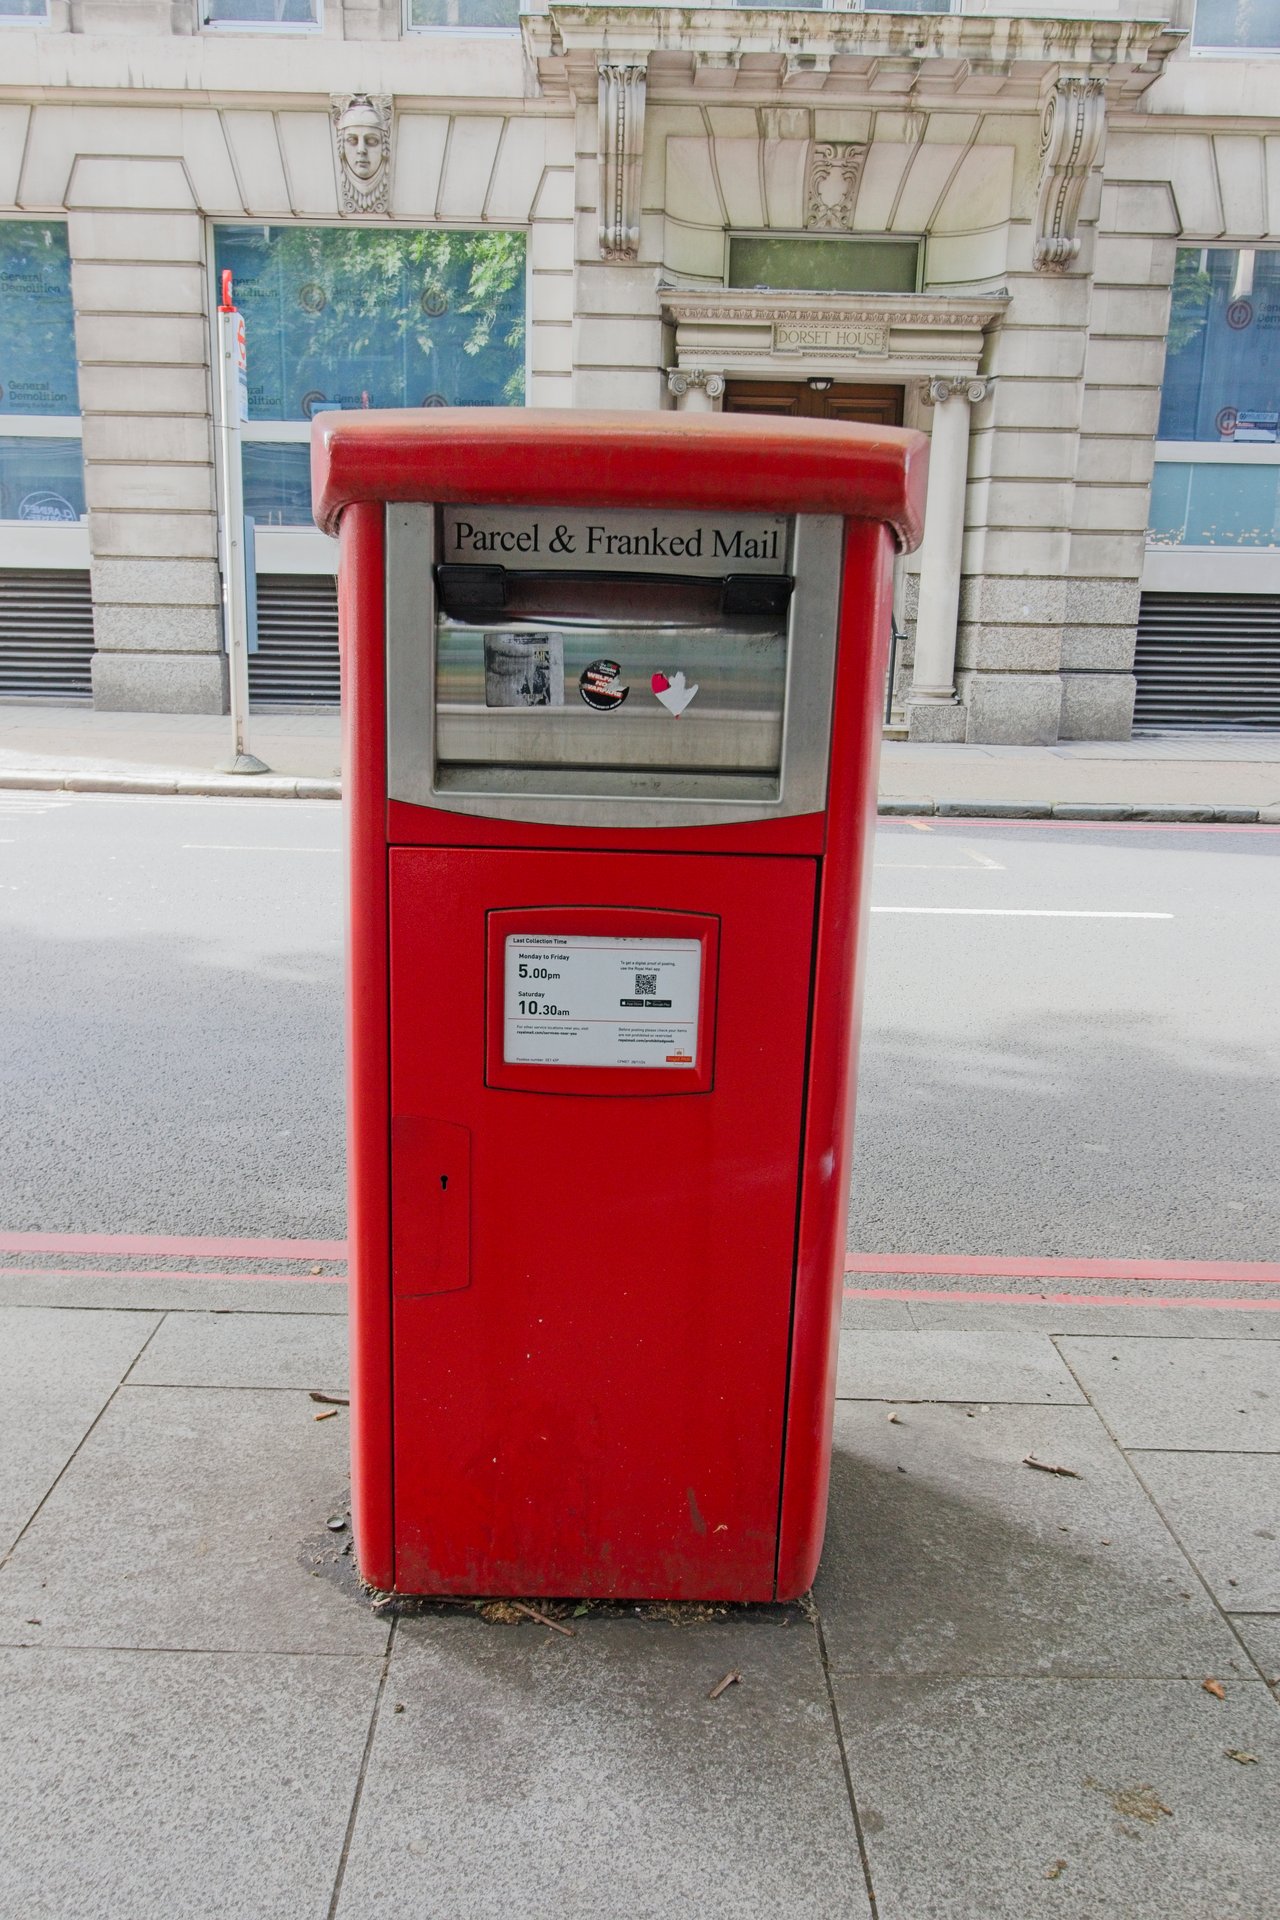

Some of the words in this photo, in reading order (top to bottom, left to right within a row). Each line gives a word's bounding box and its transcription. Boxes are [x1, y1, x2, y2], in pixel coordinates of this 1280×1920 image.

[779, 330, 831, 344] DORSET
[836, 332, 880, 346] HOUSE
[8, 381, 49, 390] General
[9, 391, 67, 401] Demolition
[454, 522, 540, 552] Parcel
[549, 525, 576, 553] &
[586, 526, 703, 557] Franked
[712, 530, 778, 559] Mail
[519, 964, 560, 980] 5.00pm
[519, 1000, 570, 1015] 10.30am
